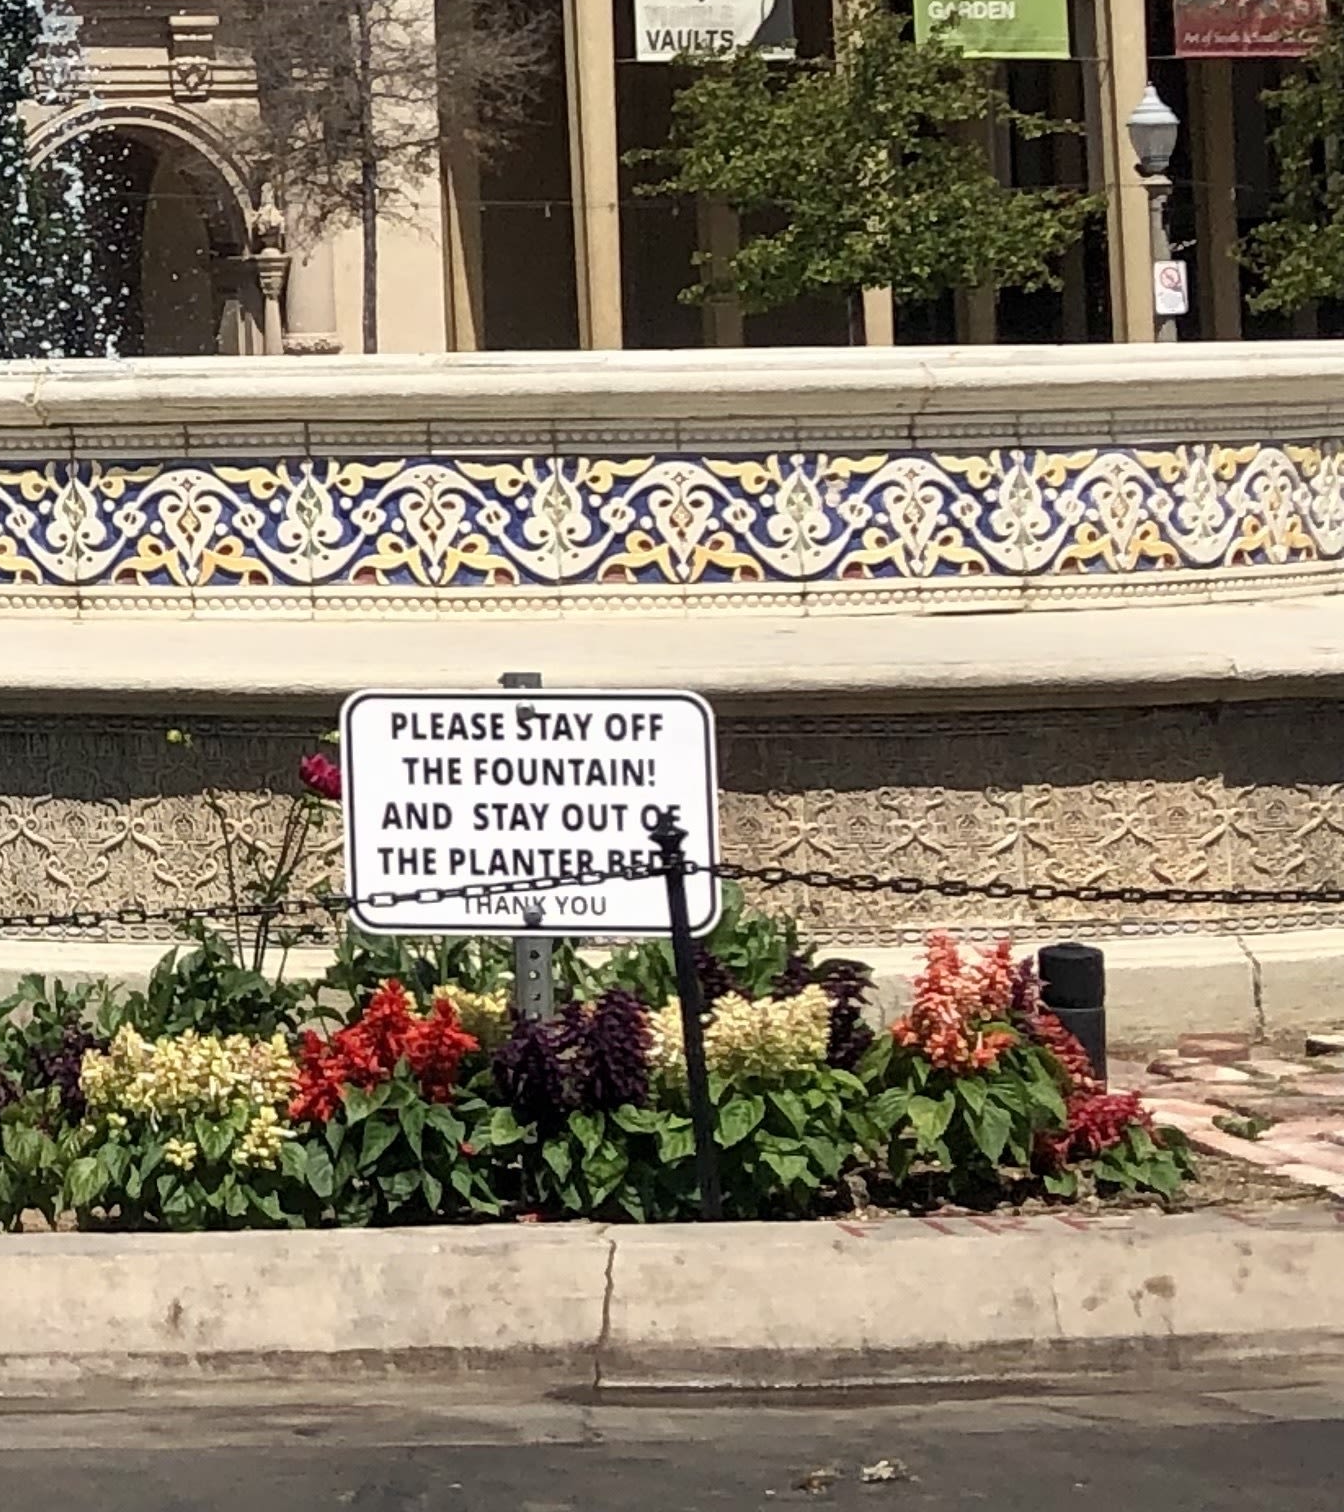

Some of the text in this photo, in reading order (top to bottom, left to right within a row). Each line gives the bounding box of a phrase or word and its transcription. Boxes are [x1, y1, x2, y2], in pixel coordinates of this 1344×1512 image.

[927, 0, 1016, 20] GARDEN
[645, 29, 735, 51] VAULTS
[391, 712, 664, 741] PLEASE STAY OFF
[403, 757, 656, 787] THE FOUNTAIN!
[381, 802, 453, 830] AND
[473, 803, 550, 831] STAY
[561, 804, 628, 831] OUT
[377, 847, 436, 875] THE
[449, 848, 595, 877] PLANTER
[464, 895, 607, 916] THANK YOU
